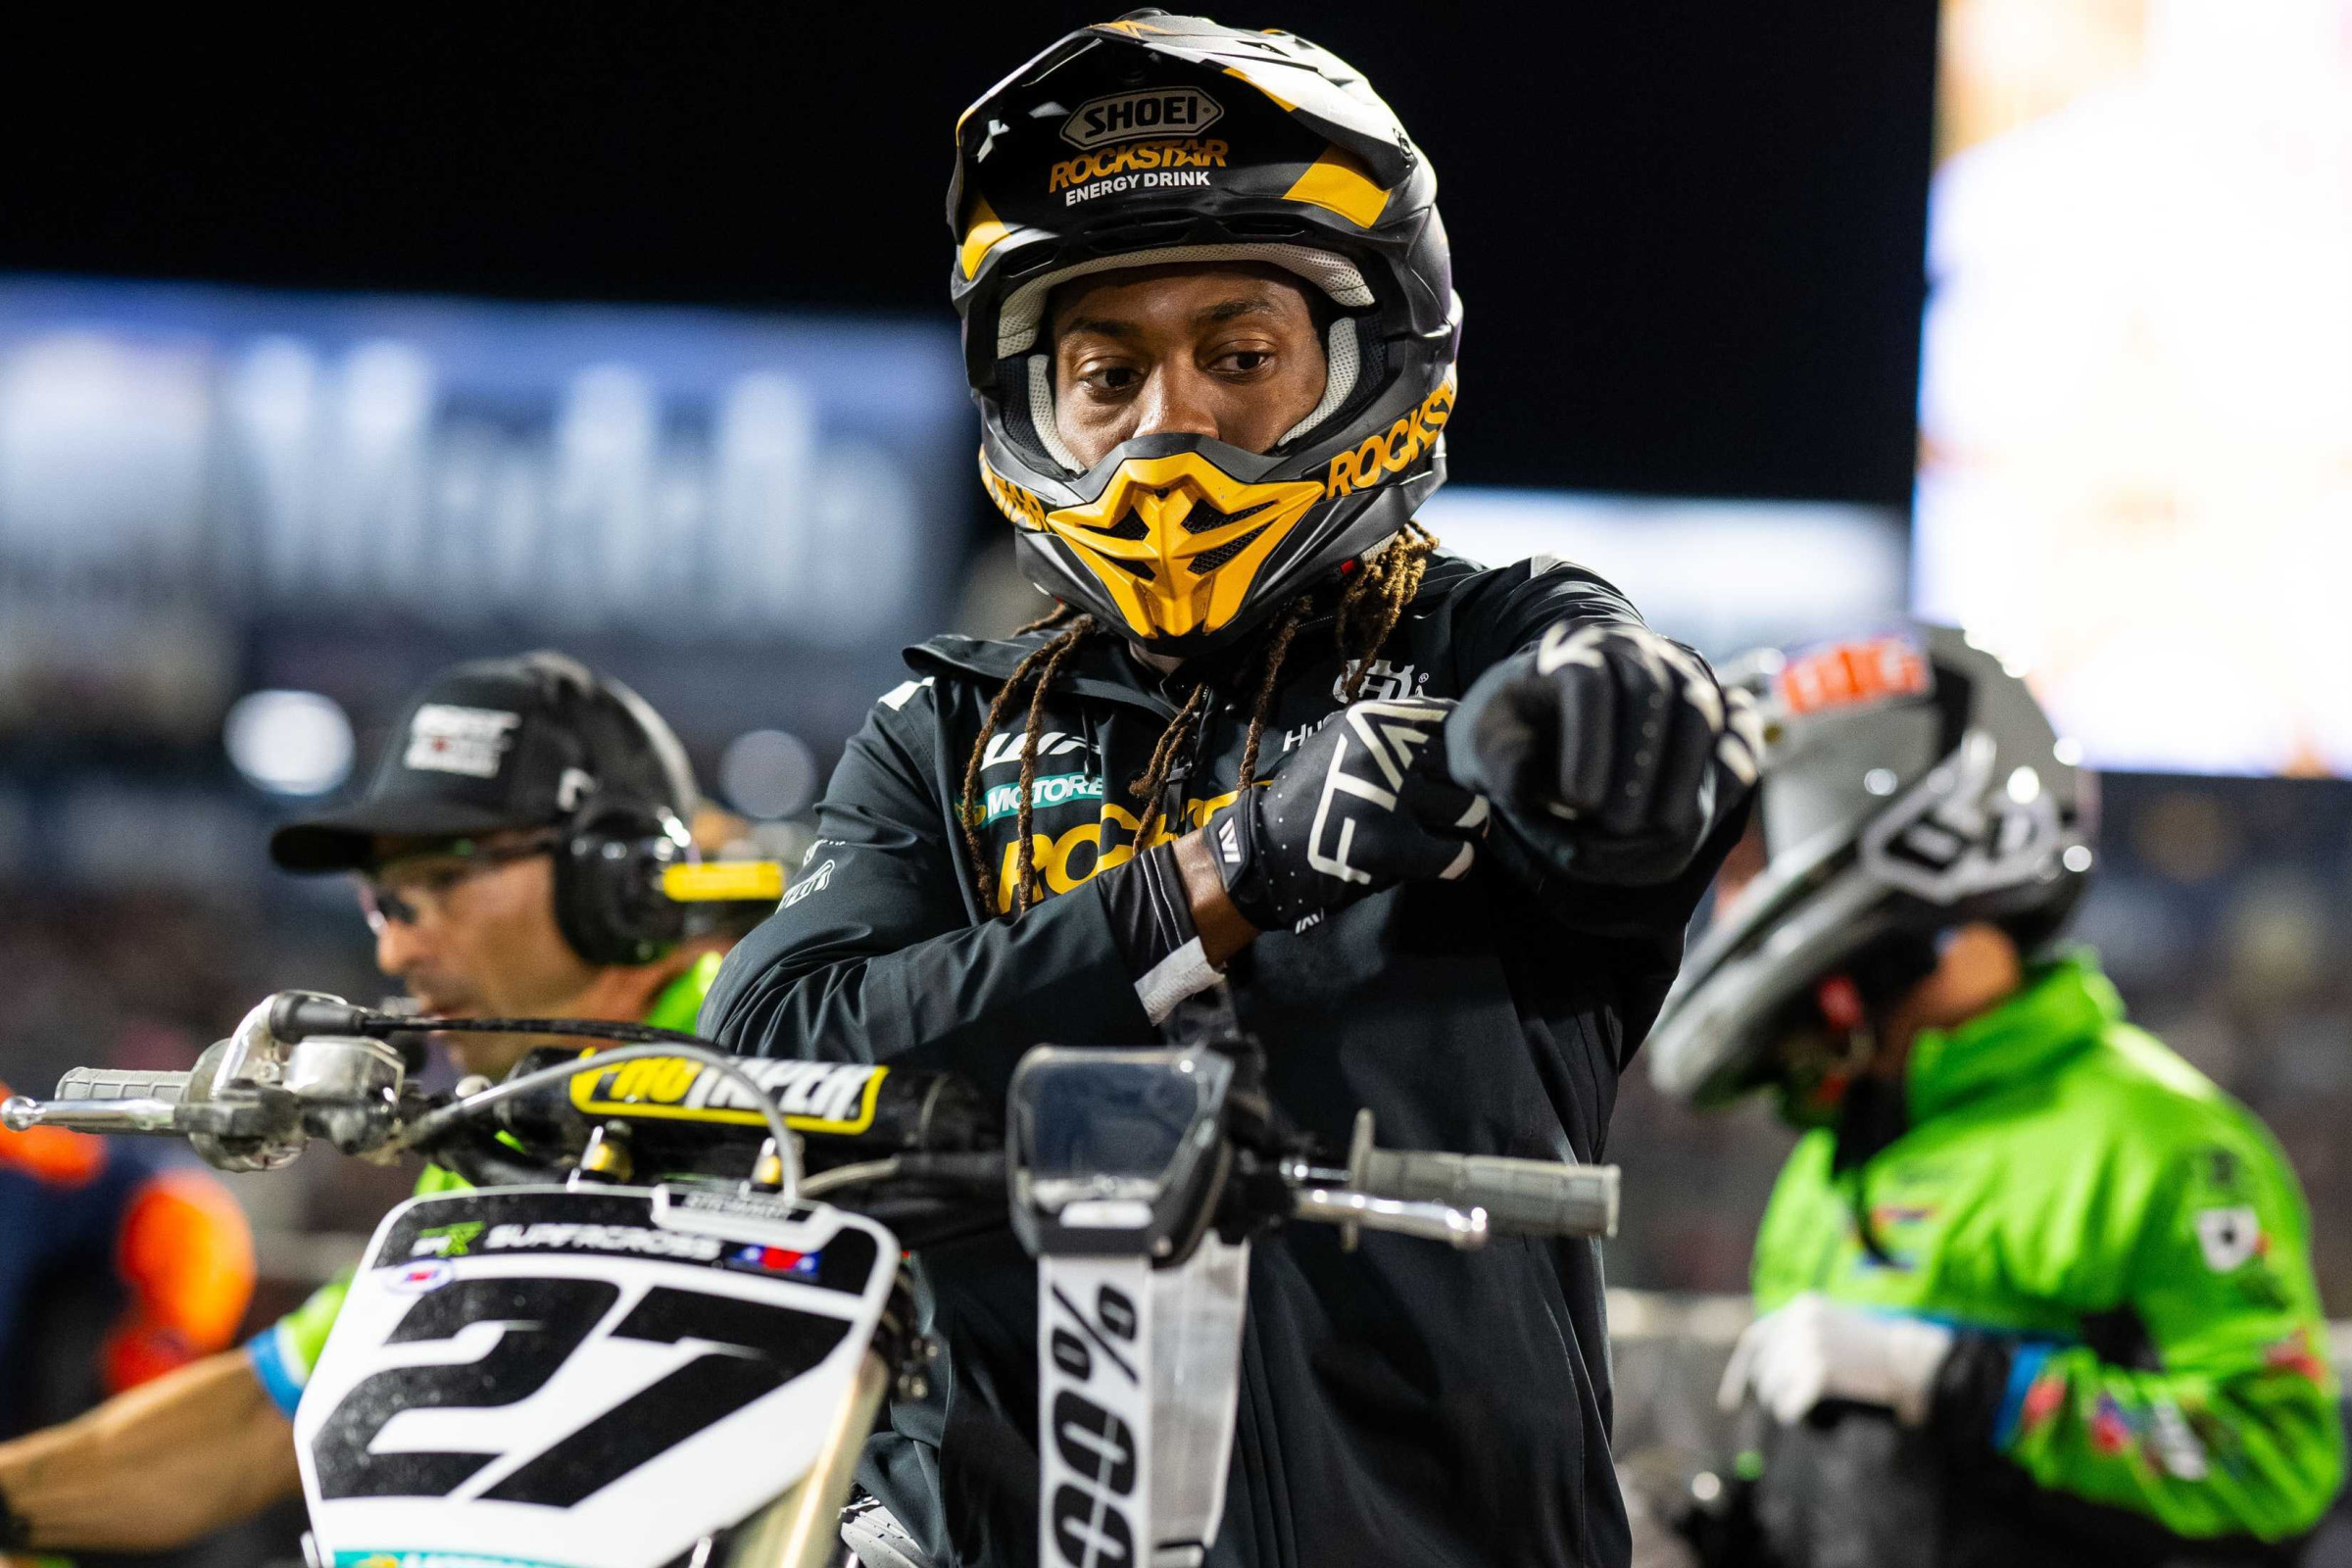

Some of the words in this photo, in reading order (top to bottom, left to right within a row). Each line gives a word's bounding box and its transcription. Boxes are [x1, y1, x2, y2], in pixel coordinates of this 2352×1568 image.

[1084, 96, 1198, 139] SHOEI
[1049, 139, 1229, 194] ROCKSTAR
[1065, 173, 1141, 207] ENERGY
[1144, 171, 1211, 188] DRINK
[312, 1277, 855, 1508] 27
